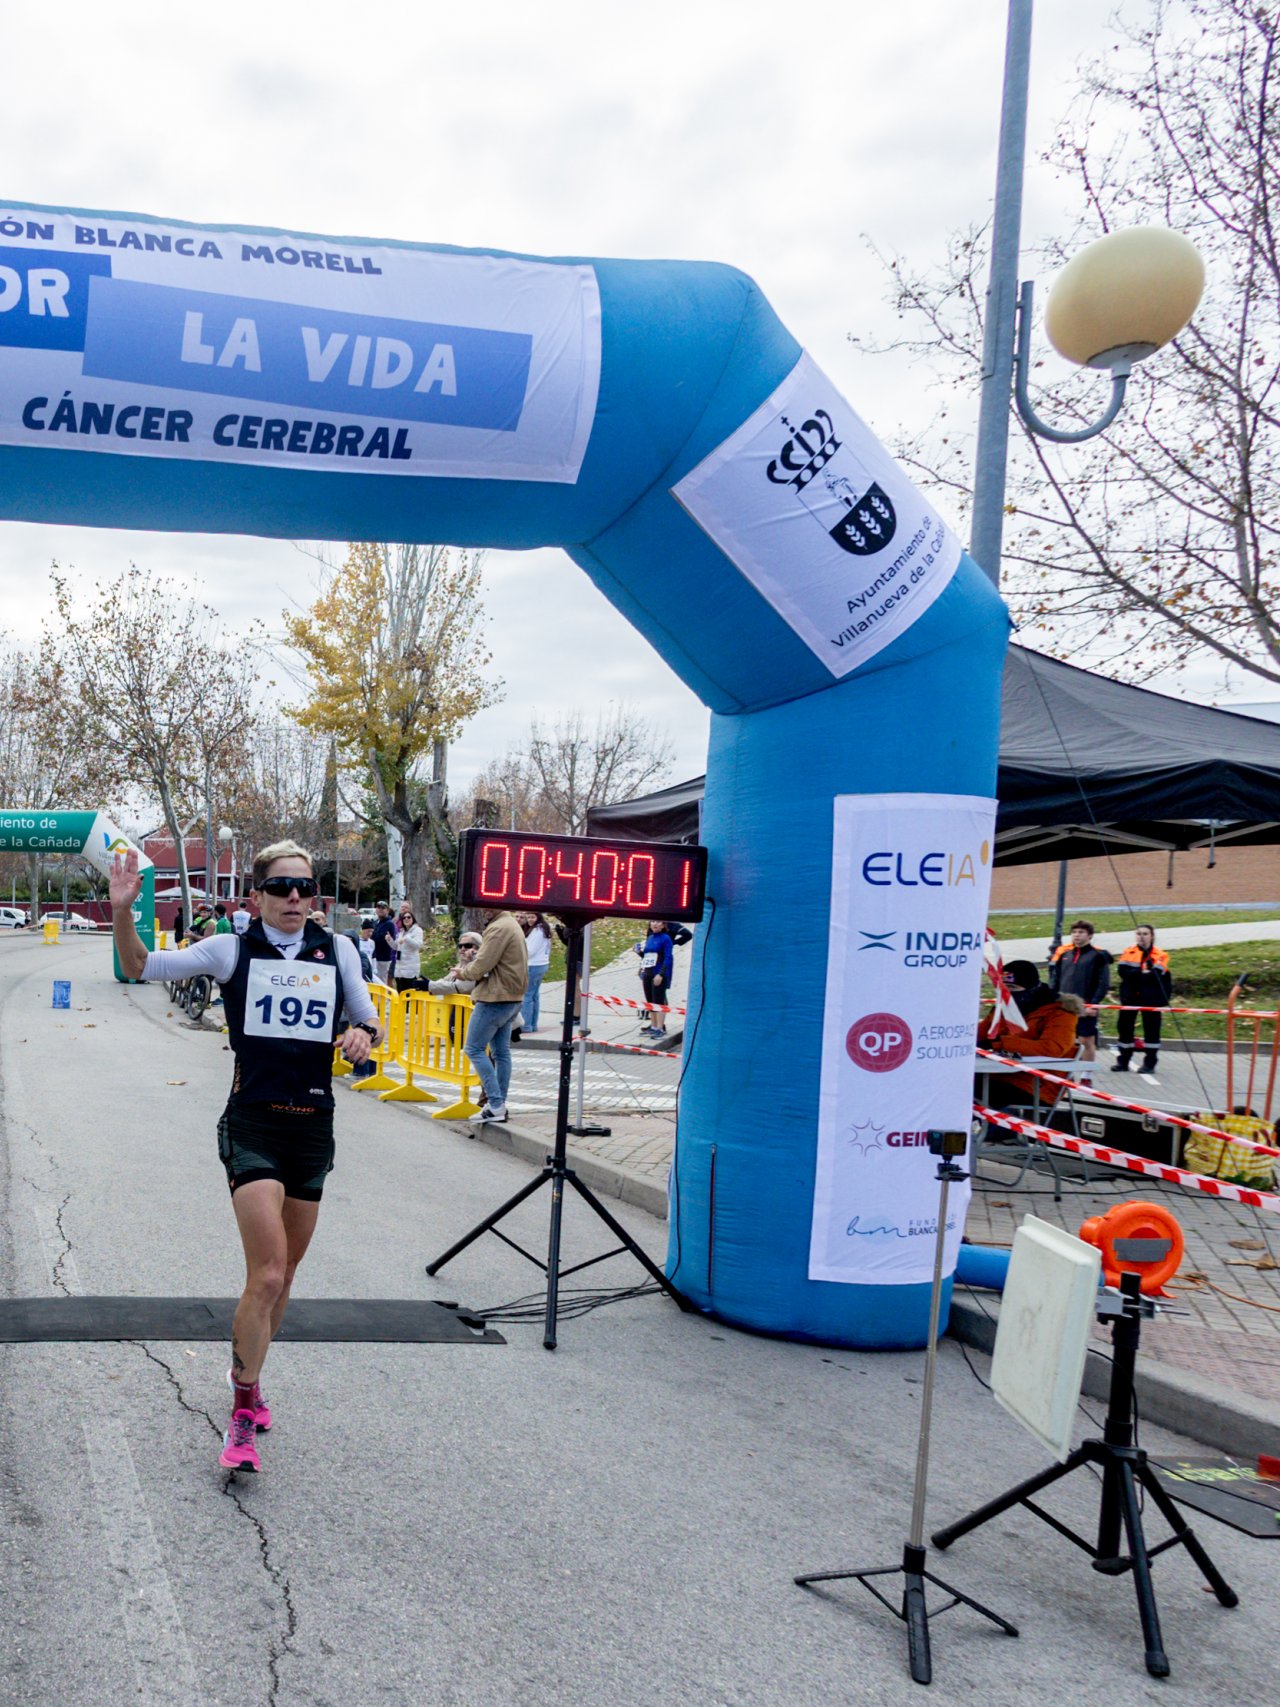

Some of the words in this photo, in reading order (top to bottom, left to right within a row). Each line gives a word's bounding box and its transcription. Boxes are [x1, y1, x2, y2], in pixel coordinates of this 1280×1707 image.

[75, 225, 222, 260] BLANCA
[241, 244, 382, 275] MORELL
[181, 311, 261, 372] LA
[301, 327, 457, 396] VIDA
[22, 390, 193, 442] CÁNCER
[213, 414, 413, 460] CEREBRAL
[846, 529, 926, 614] Ayuntamiento
[831, 581, 910, 648] Villanueva
[910, 566, 926, 584] de
[922, 553, 935, 567] la
[39, 816, 57, 829] de
[11, 835, 24, 847] la
[28, 833, 81, 848] Cañada
[862, 852, 976, 886] ELEIA
[906, 932, 981, 951] INDRA
[904, 955, 967, 968] GROUP
[271, 974, 311, 988] ELEIA
[255, 995, 327, 1029] 195
[859, 1031, 902, 1057] QP
